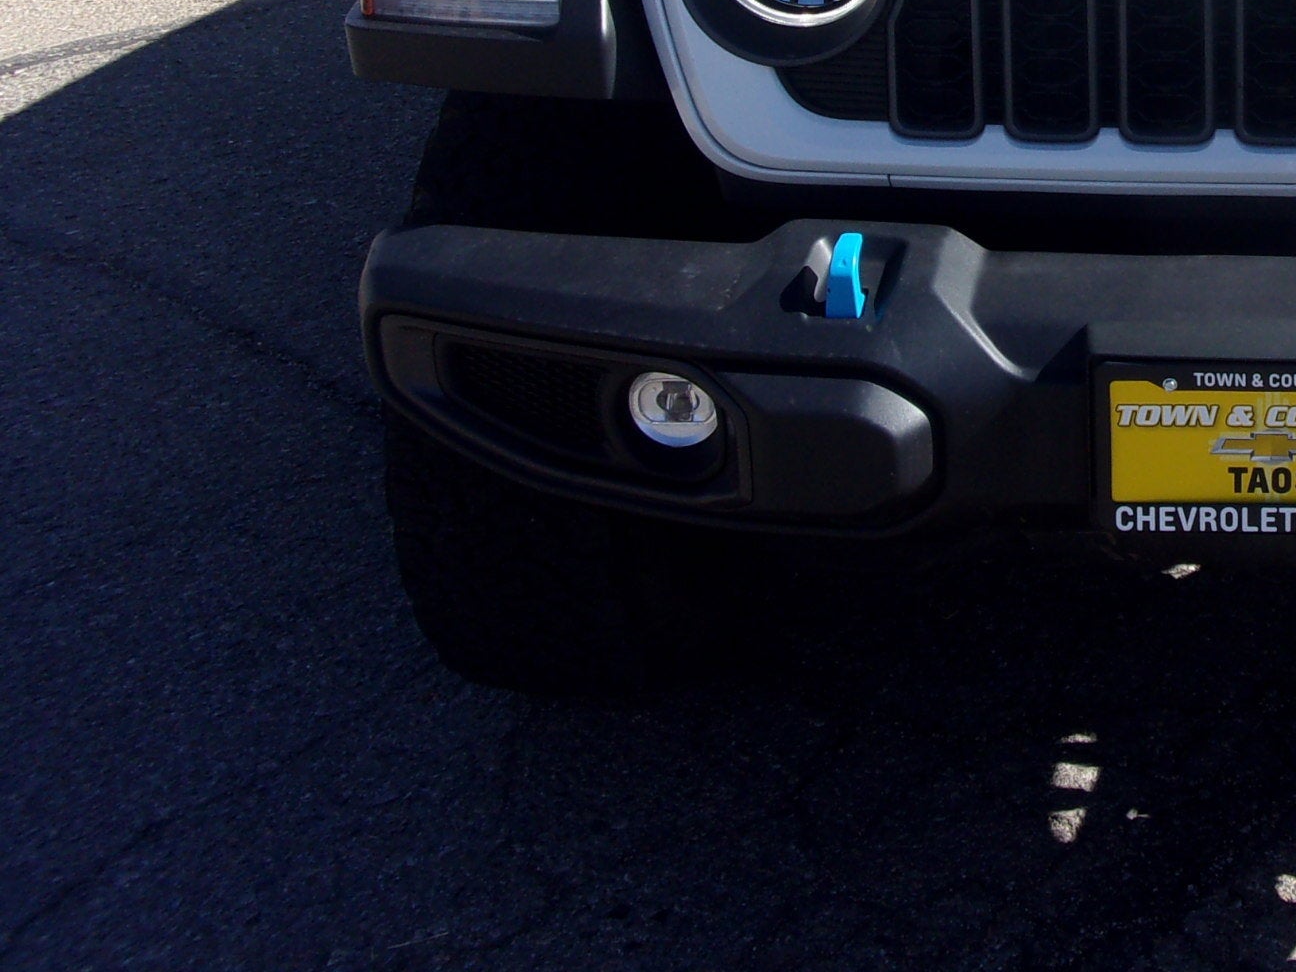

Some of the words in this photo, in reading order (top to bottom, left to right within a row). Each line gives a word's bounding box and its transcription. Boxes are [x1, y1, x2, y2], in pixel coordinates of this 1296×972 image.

[1193, 372, 1246, 387] TOWN
[1252, 373, 1264, 388] &
[1115, 404, 1219, 428] TOWN
[1226, 404, 1256, 428] &
[1115, 506, 1296, 532] CHEVROLET
